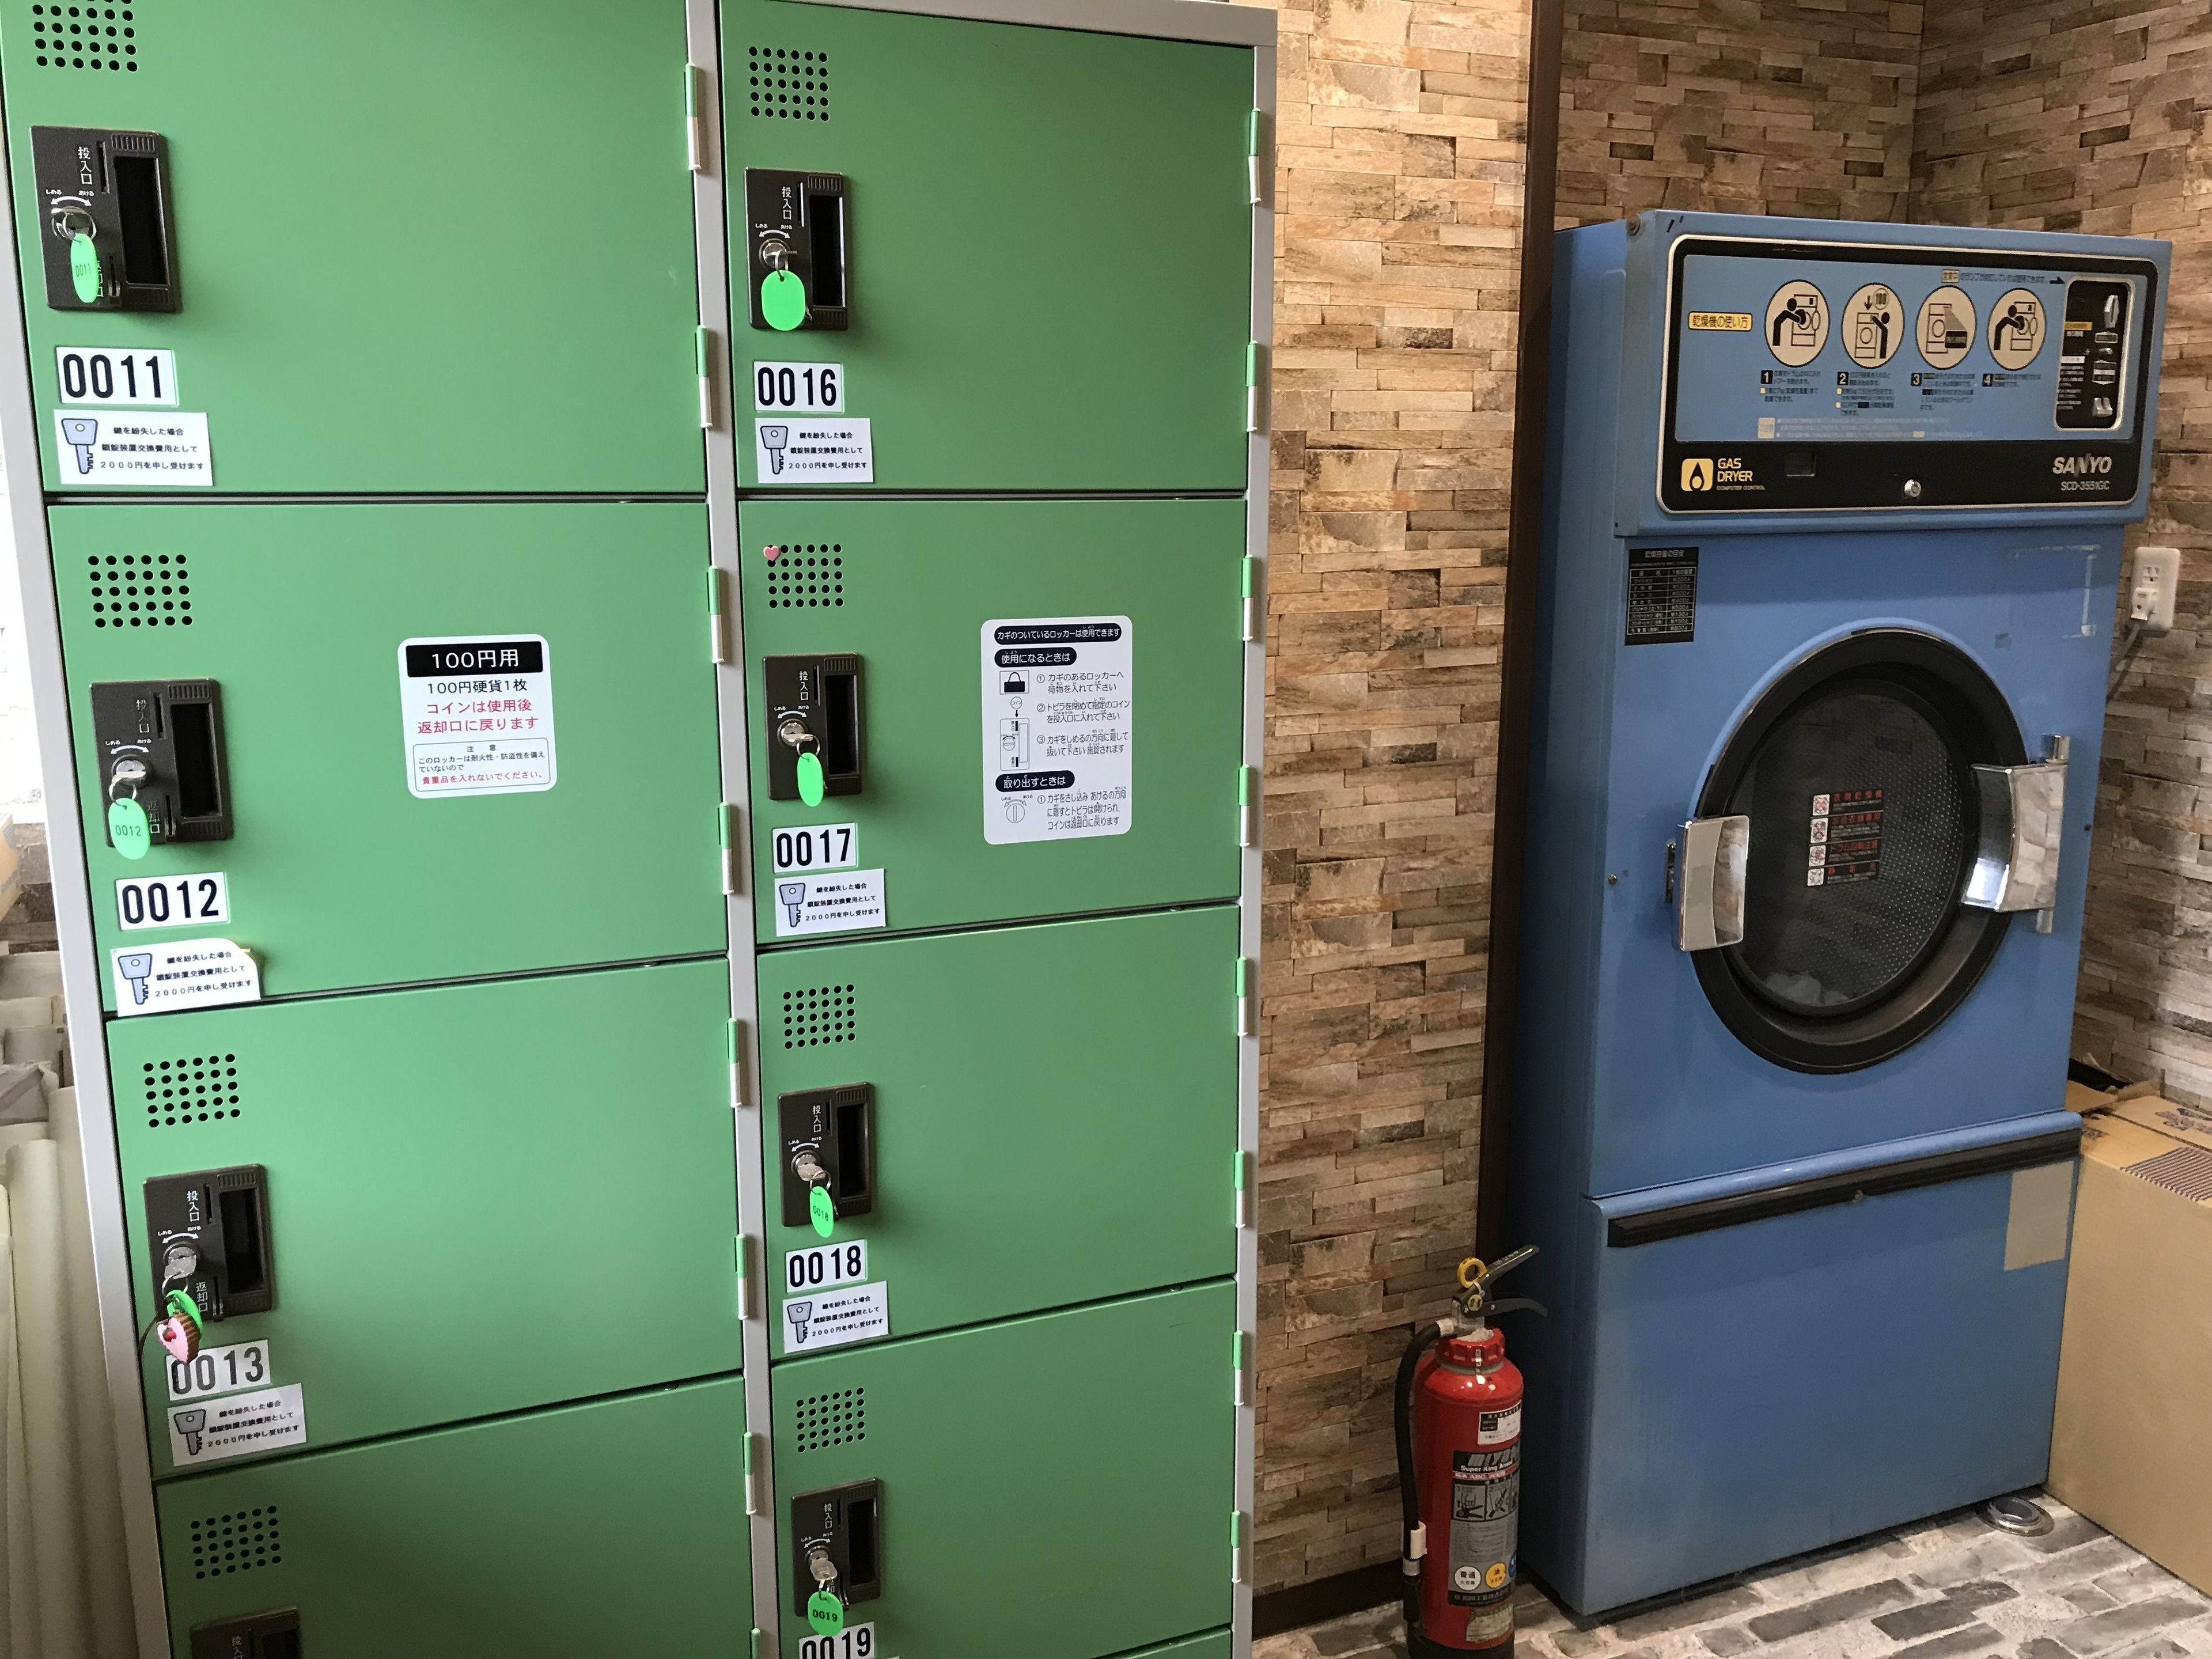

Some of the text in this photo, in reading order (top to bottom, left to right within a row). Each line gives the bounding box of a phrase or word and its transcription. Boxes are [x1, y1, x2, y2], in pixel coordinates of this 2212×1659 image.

[78, 146, 92, 185] 投入口
[782, 186, 792, 220] 投入口
[75, 263, 91, 277] 0011
[1692, 315, 1749, 328] 乾燥機の使い方
[63, 354, 161, 398] 0011
[1839, 373, 1846, 384] 2
[1913, 374, 1920, 385] 3
[1984, 374, 1991, 385] 4
[758, 367, 836, 406] 0016
[1718, 458, 1742, 469] GAS
[2052, 453, 2112, 477] SANYO
[1717, 471, 1753, 482] DRYER
[997, 628, 1120, 640] カギのついているロッカーは使用できます
[432, 649, 518, 669] 100円用
[1001, 653, 1070, 664] 使用になるときは
[1048, 671, 1124, 681] カギのあるロッカーへ
[427, 679, 527, 694] 100円硬貨1枚
[799, 671, 809, 700] 投入口
[1048, 684, 1116, 694] 荷物を入れて下さい
[427, 699, 532, 714] コインは使用後
[1047, 700, 1130, 711] トビラを閉めて指定のコイン
[418, 716, 539, 734] 返却口に戻ります
[1047, 713, 1120, 724] を投入口に入れて下さい
[419, 751, 545, 764] このロッカーは耐火性・防盗性を備え
[419, 764, 464, 772] ていないので
[422, 771, 543, 785] 貴重品を入れないでください。
[1003, 776, 1066, 789] 取り出すときは
[1090, 790, 1126, 800] あけるの方向
[115, 825, 142, 836] 0012
[1047, 817, 1119, 830] コインは返却口に戻ります
[777, 828, 850, 868] 0017
[122, 879, 219, 924] 0012
[813, 1105, 821, 1132] 投入口
[187, 1190, 200, 1222] 投入口
[813, 1205, 829, 1221] 0018
[790, 1245, 861, 1287] 0018
[196, 1282, 207, 1312] 返却口
[171, 1347, 263, 1395] 0013
[824, 1503, 832, 1529] 投入口
[812, 1609, 838, 1622] 0019
[802, 1627, 870, 1659] 0019
